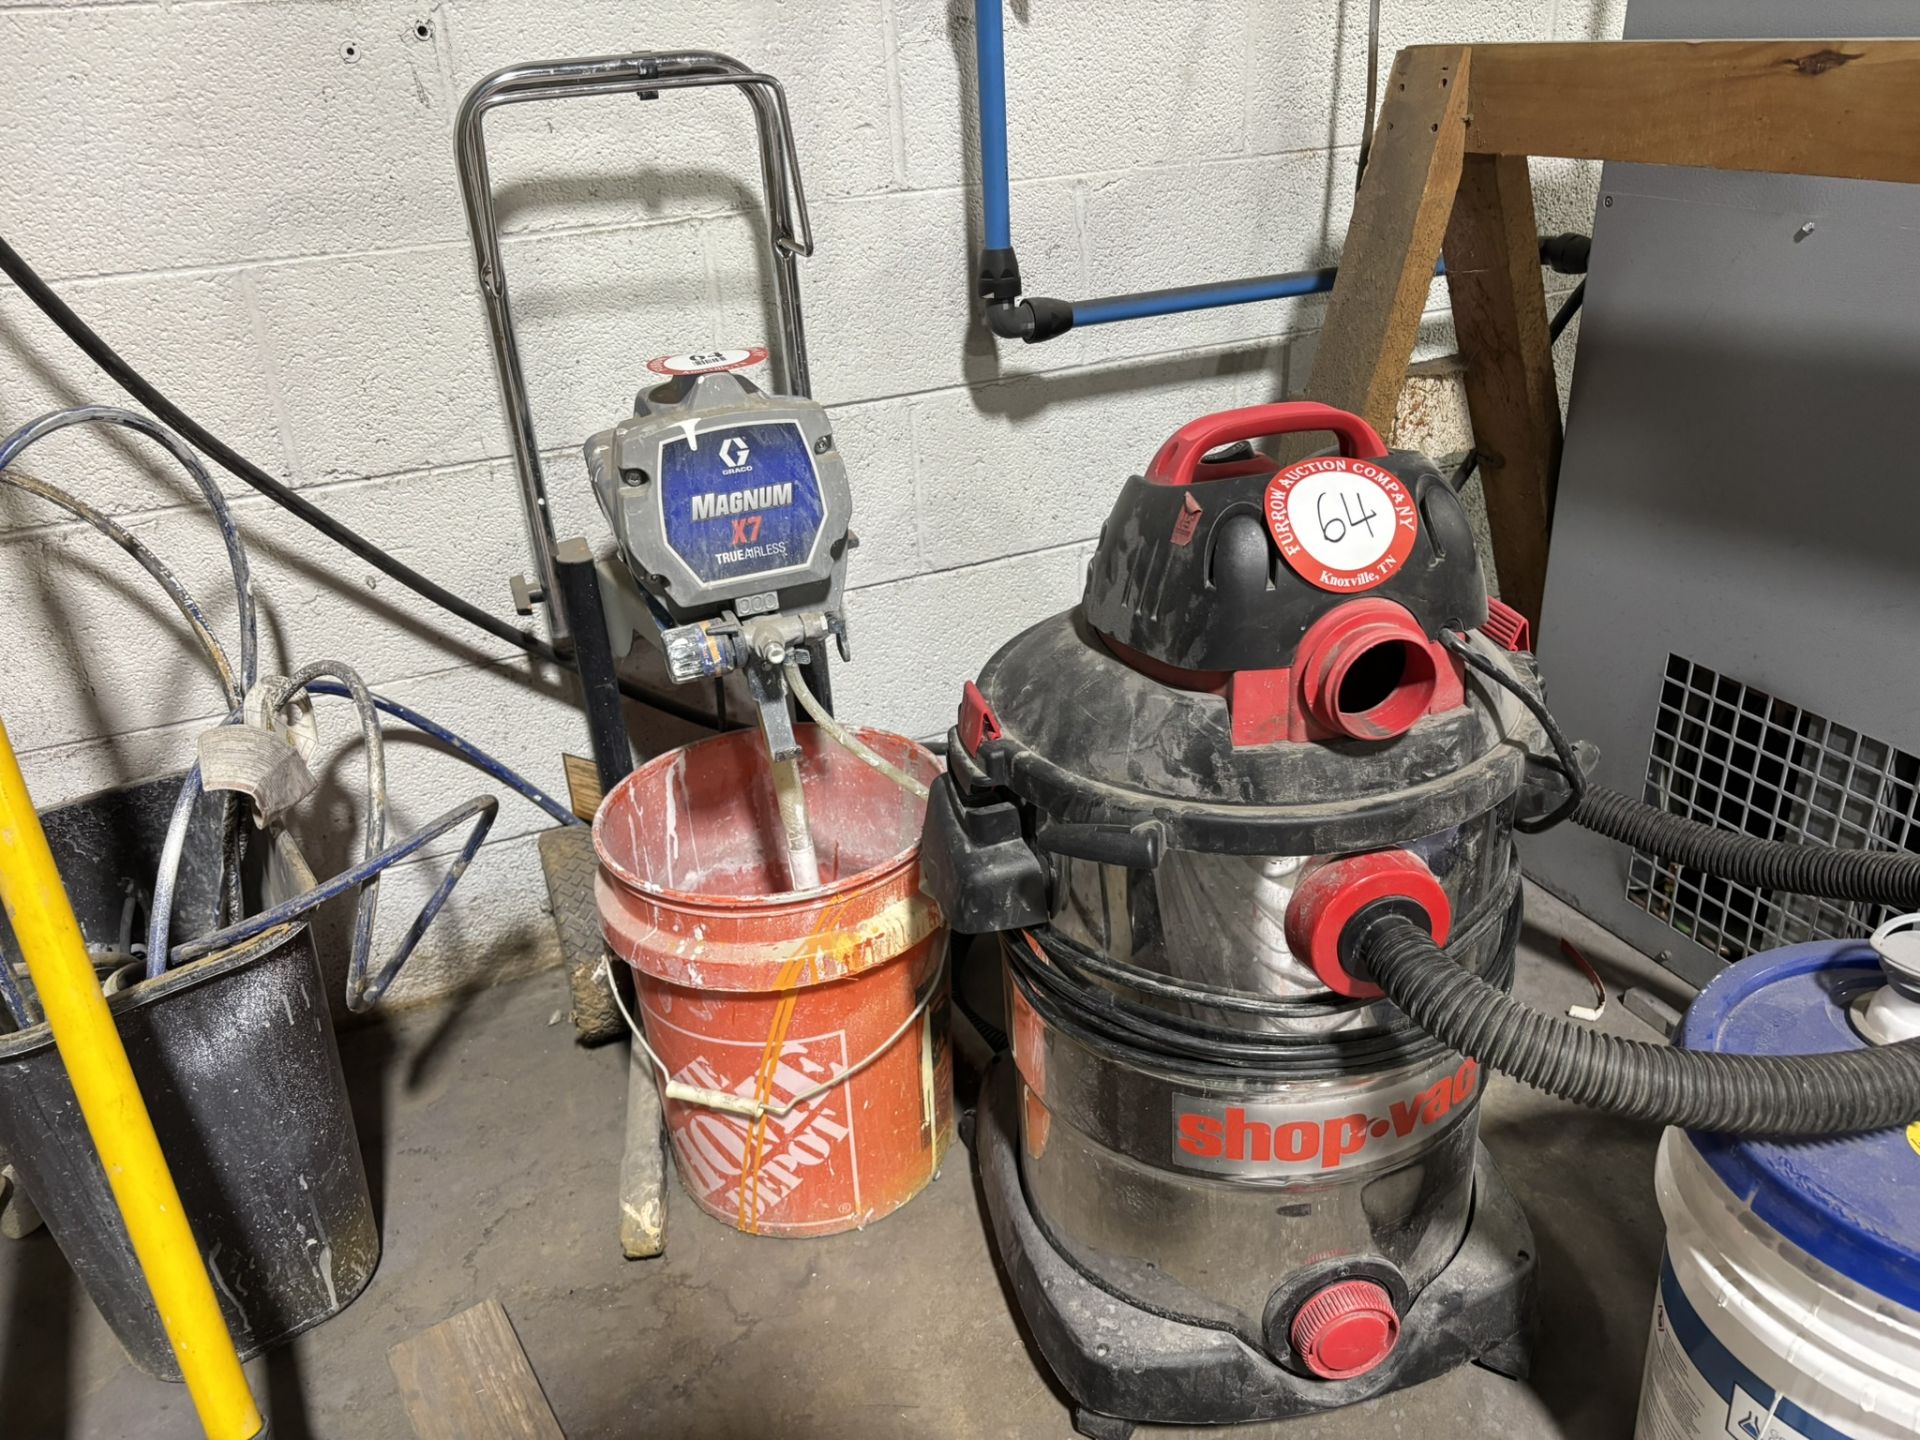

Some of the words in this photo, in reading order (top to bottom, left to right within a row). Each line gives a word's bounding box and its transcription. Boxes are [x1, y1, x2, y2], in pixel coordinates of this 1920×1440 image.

[722, 465, 753, 475] GRACO
[1279, 459, 1347, 489] AUCTION
[691, 482, 793, 522] MAGNUM
[1352, 463, 1415, 531] COMPANY
[731, 516, 763, 545] X7
[1269, 487, 1301, 557] FURROW
[1317, 491, 1377, 544] 64
[1319, 570, 1380, 587] Knoxville,
[1376, 554, 1397, 574] TN
